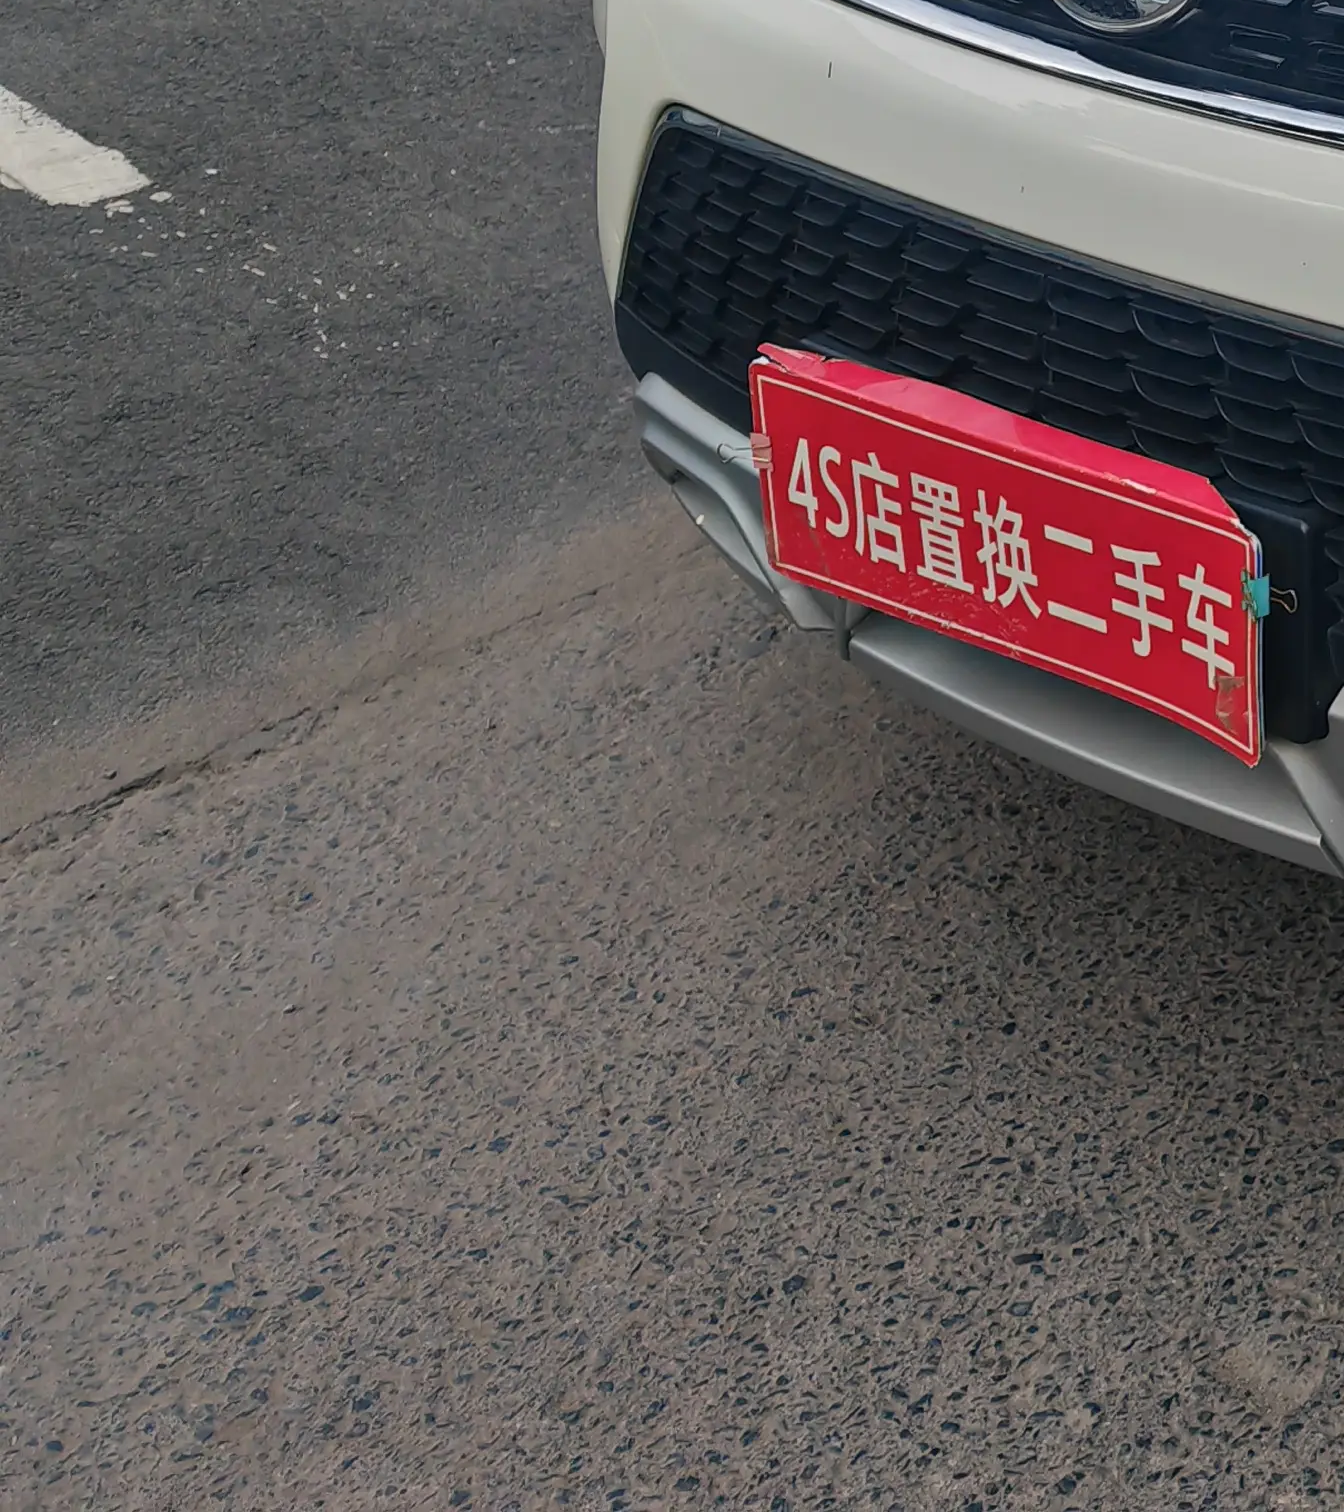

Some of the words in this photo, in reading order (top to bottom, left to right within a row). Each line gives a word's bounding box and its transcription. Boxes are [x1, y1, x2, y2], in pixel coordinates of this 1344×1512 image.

[787, 437, 1235, 690] 4S店置换二手车
